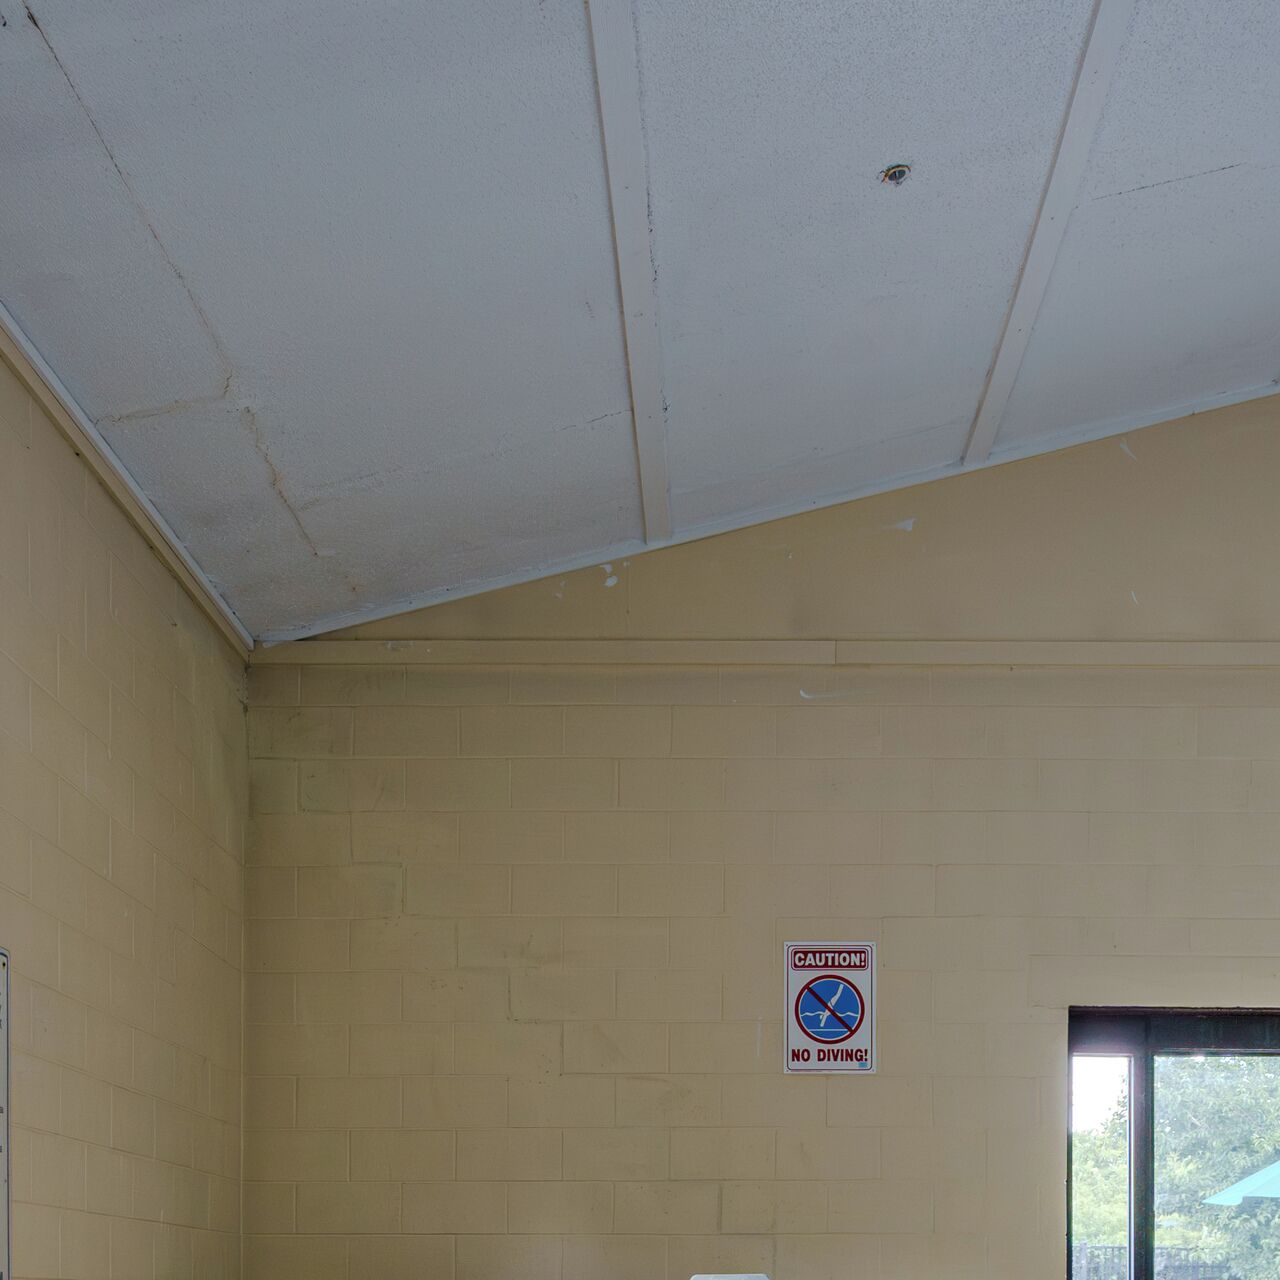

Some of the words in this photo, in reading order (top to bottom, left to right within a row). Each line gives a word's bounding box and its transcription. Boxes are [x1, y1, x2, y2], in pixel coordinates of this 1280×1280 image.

[795, 952, 865, 966] CAUTION!
[792, 1049, 811, 1062] NO
[817, 1049, 868, 1062] DIVING!
